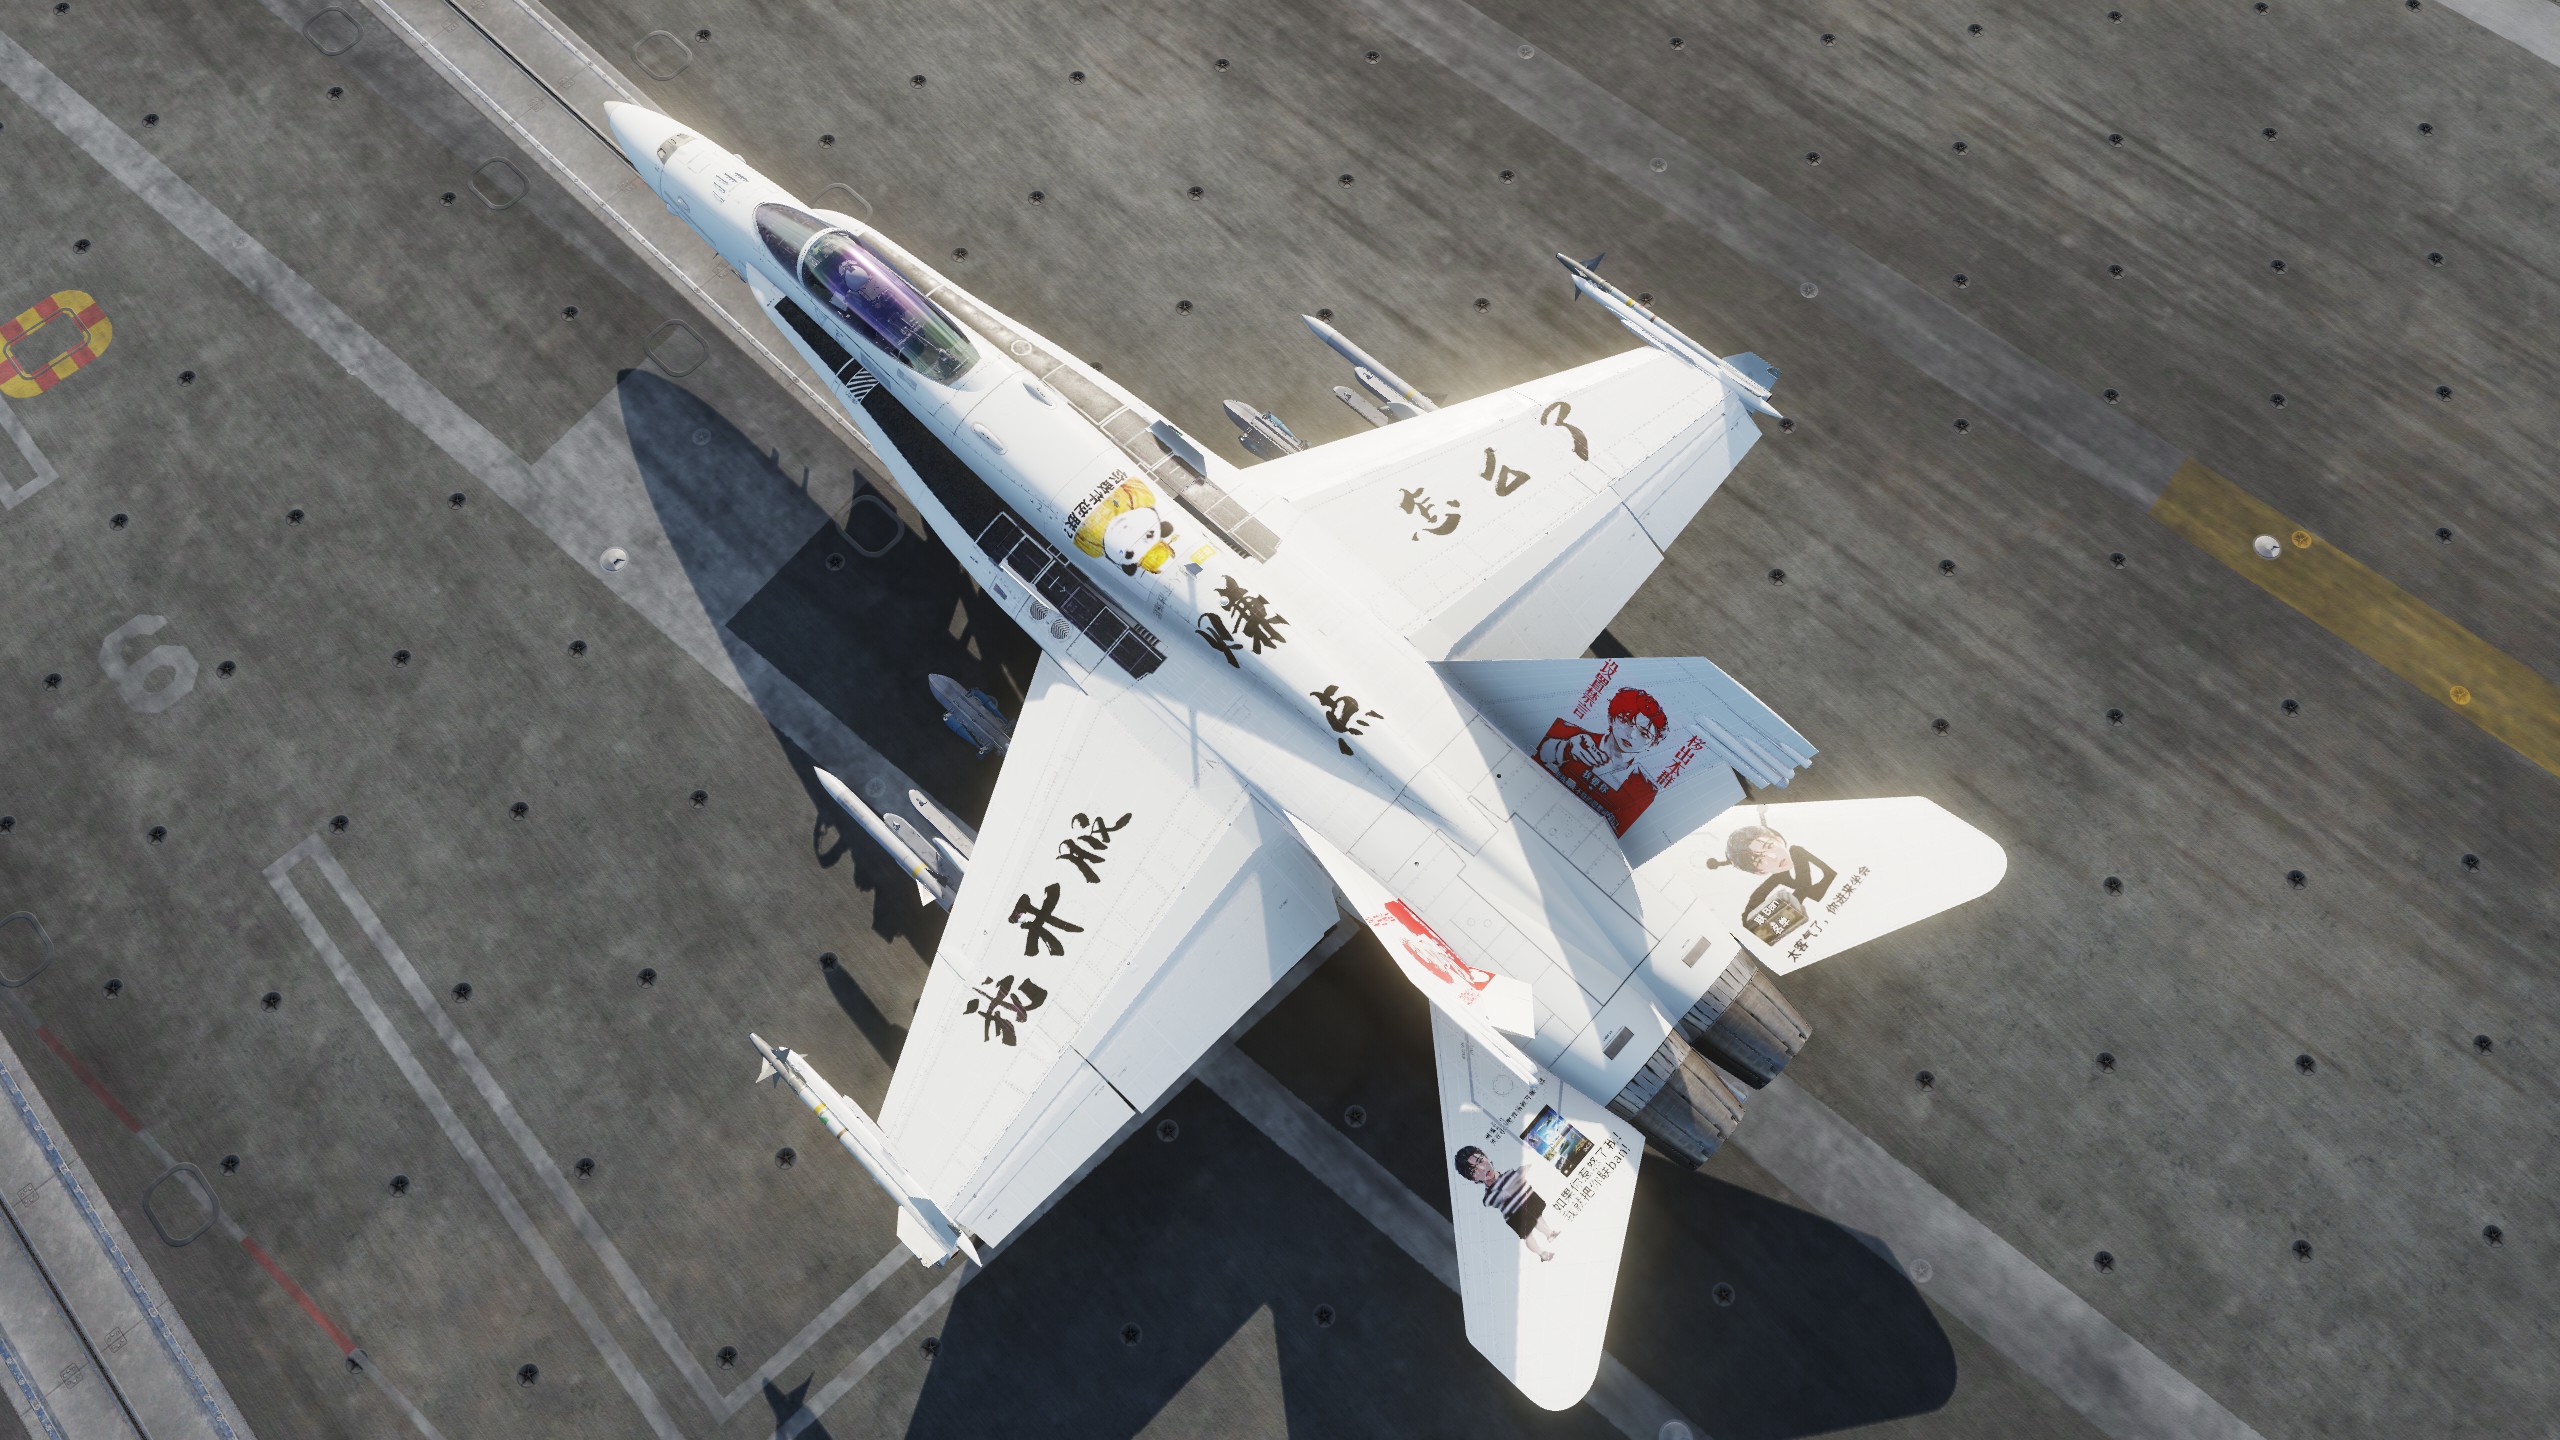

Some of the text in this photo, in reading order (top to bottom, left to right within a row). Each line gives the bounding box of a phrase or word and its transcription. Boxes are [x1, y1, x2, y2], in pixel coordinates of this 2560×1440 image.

[1572, 658, 1619, 720] 设置禁言
[1655, 733, 1708, 790] 移出本群
[1763, 900, 1779, 915] Ban
[1771, 916, 1791, 937] 名单
